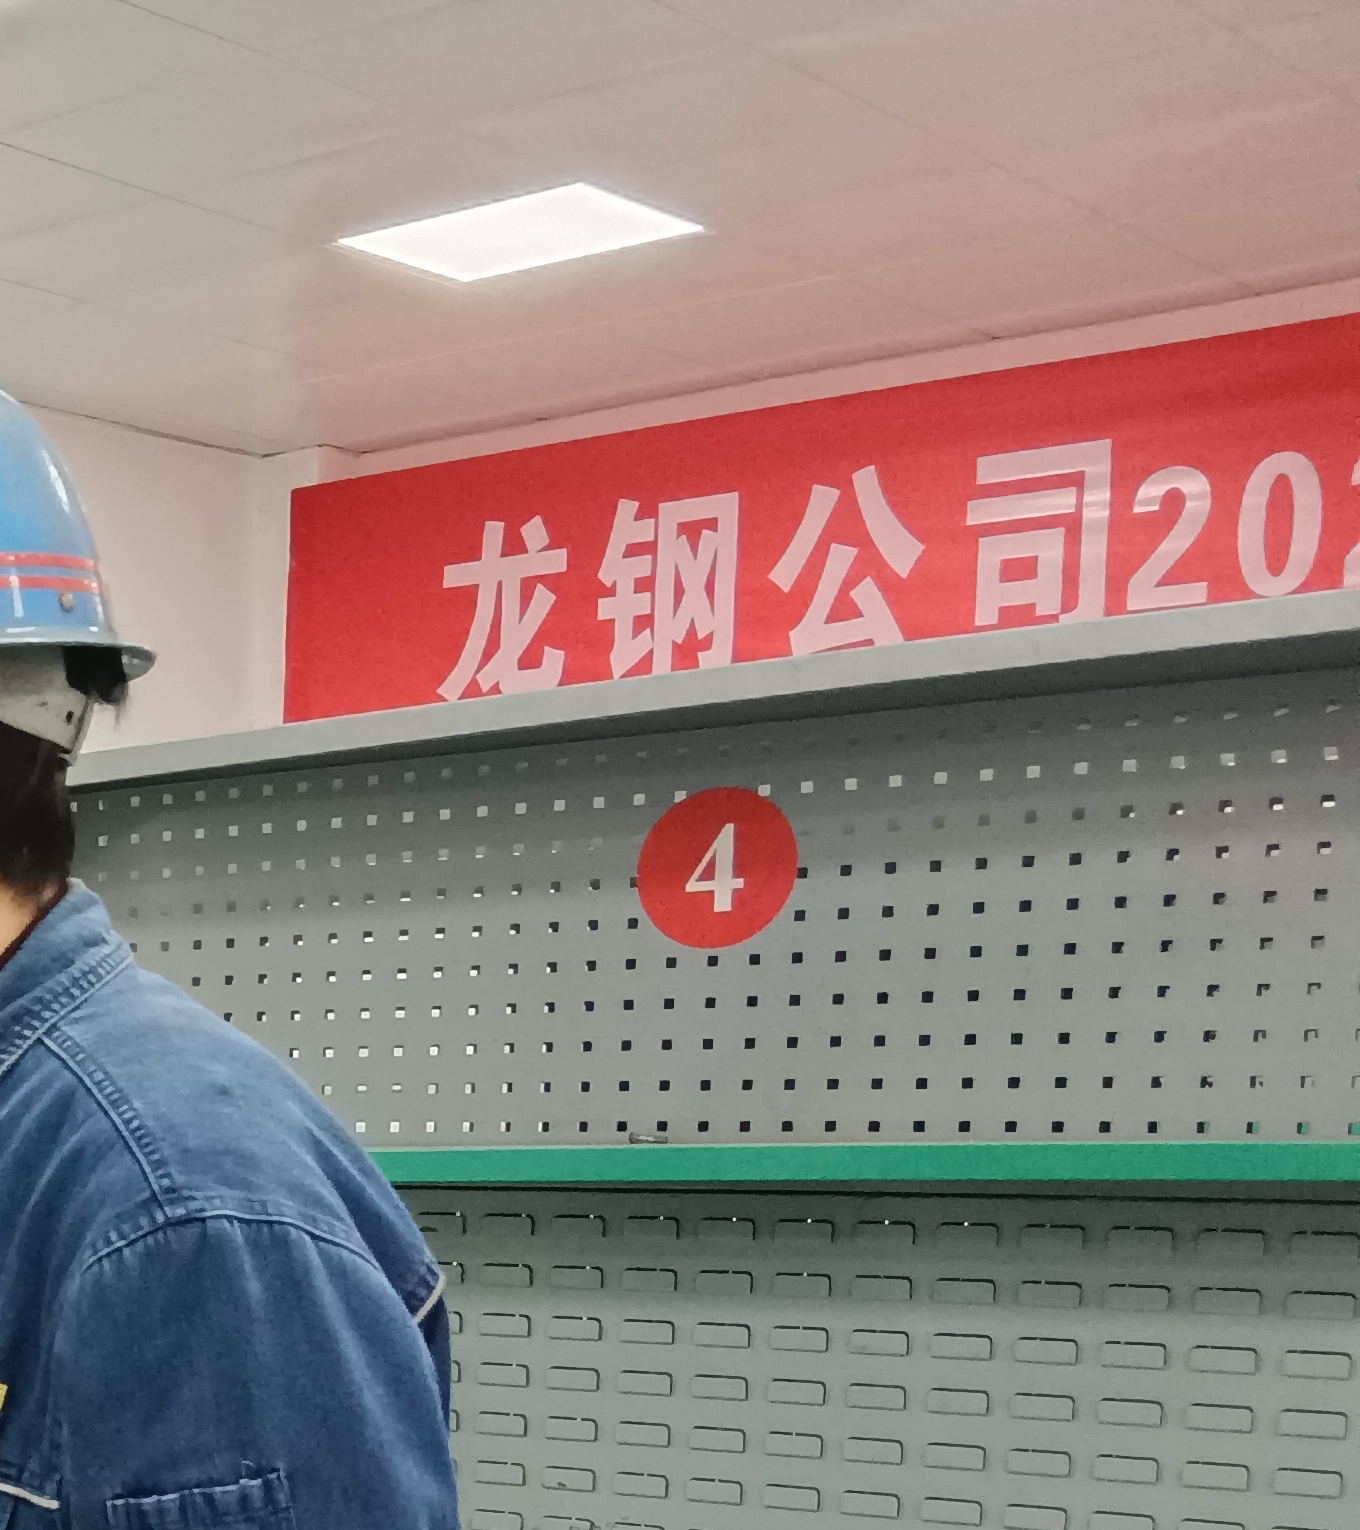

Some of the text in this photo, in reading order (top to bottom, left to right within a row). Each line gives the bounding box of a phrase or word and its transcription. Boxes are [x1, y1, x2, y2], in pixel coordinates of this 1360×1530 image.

[436, 438, 1360, 701] 龙钢公司20
[685, 822, 745, 913] 4
